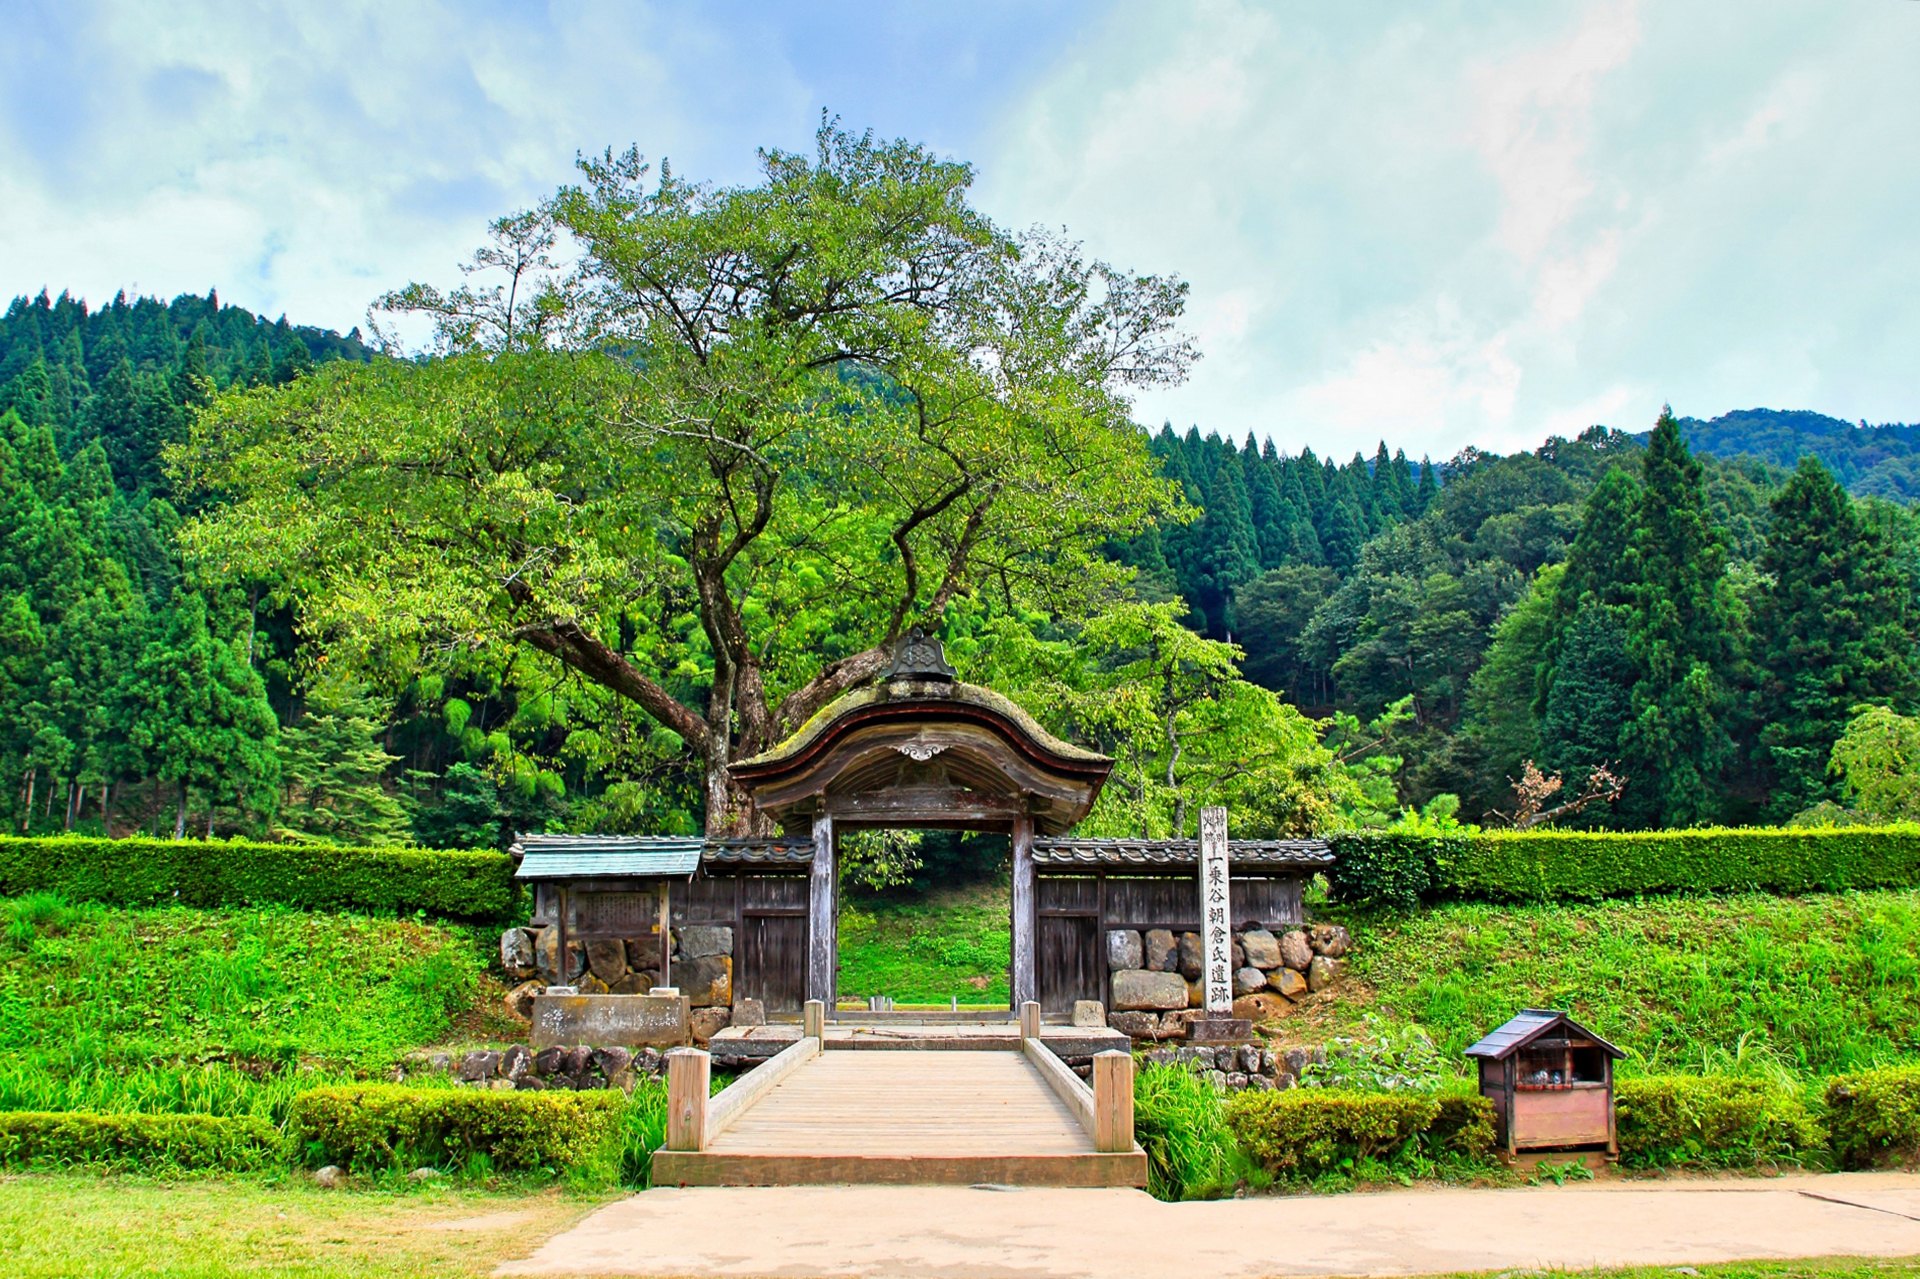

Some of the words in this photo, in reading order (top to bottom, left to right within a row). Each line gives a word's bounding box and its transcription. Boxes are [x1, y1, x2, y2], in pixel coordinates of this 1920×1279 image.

[1207, 856, 1230, 1003] 一乗谷朝倉氏遺跡
